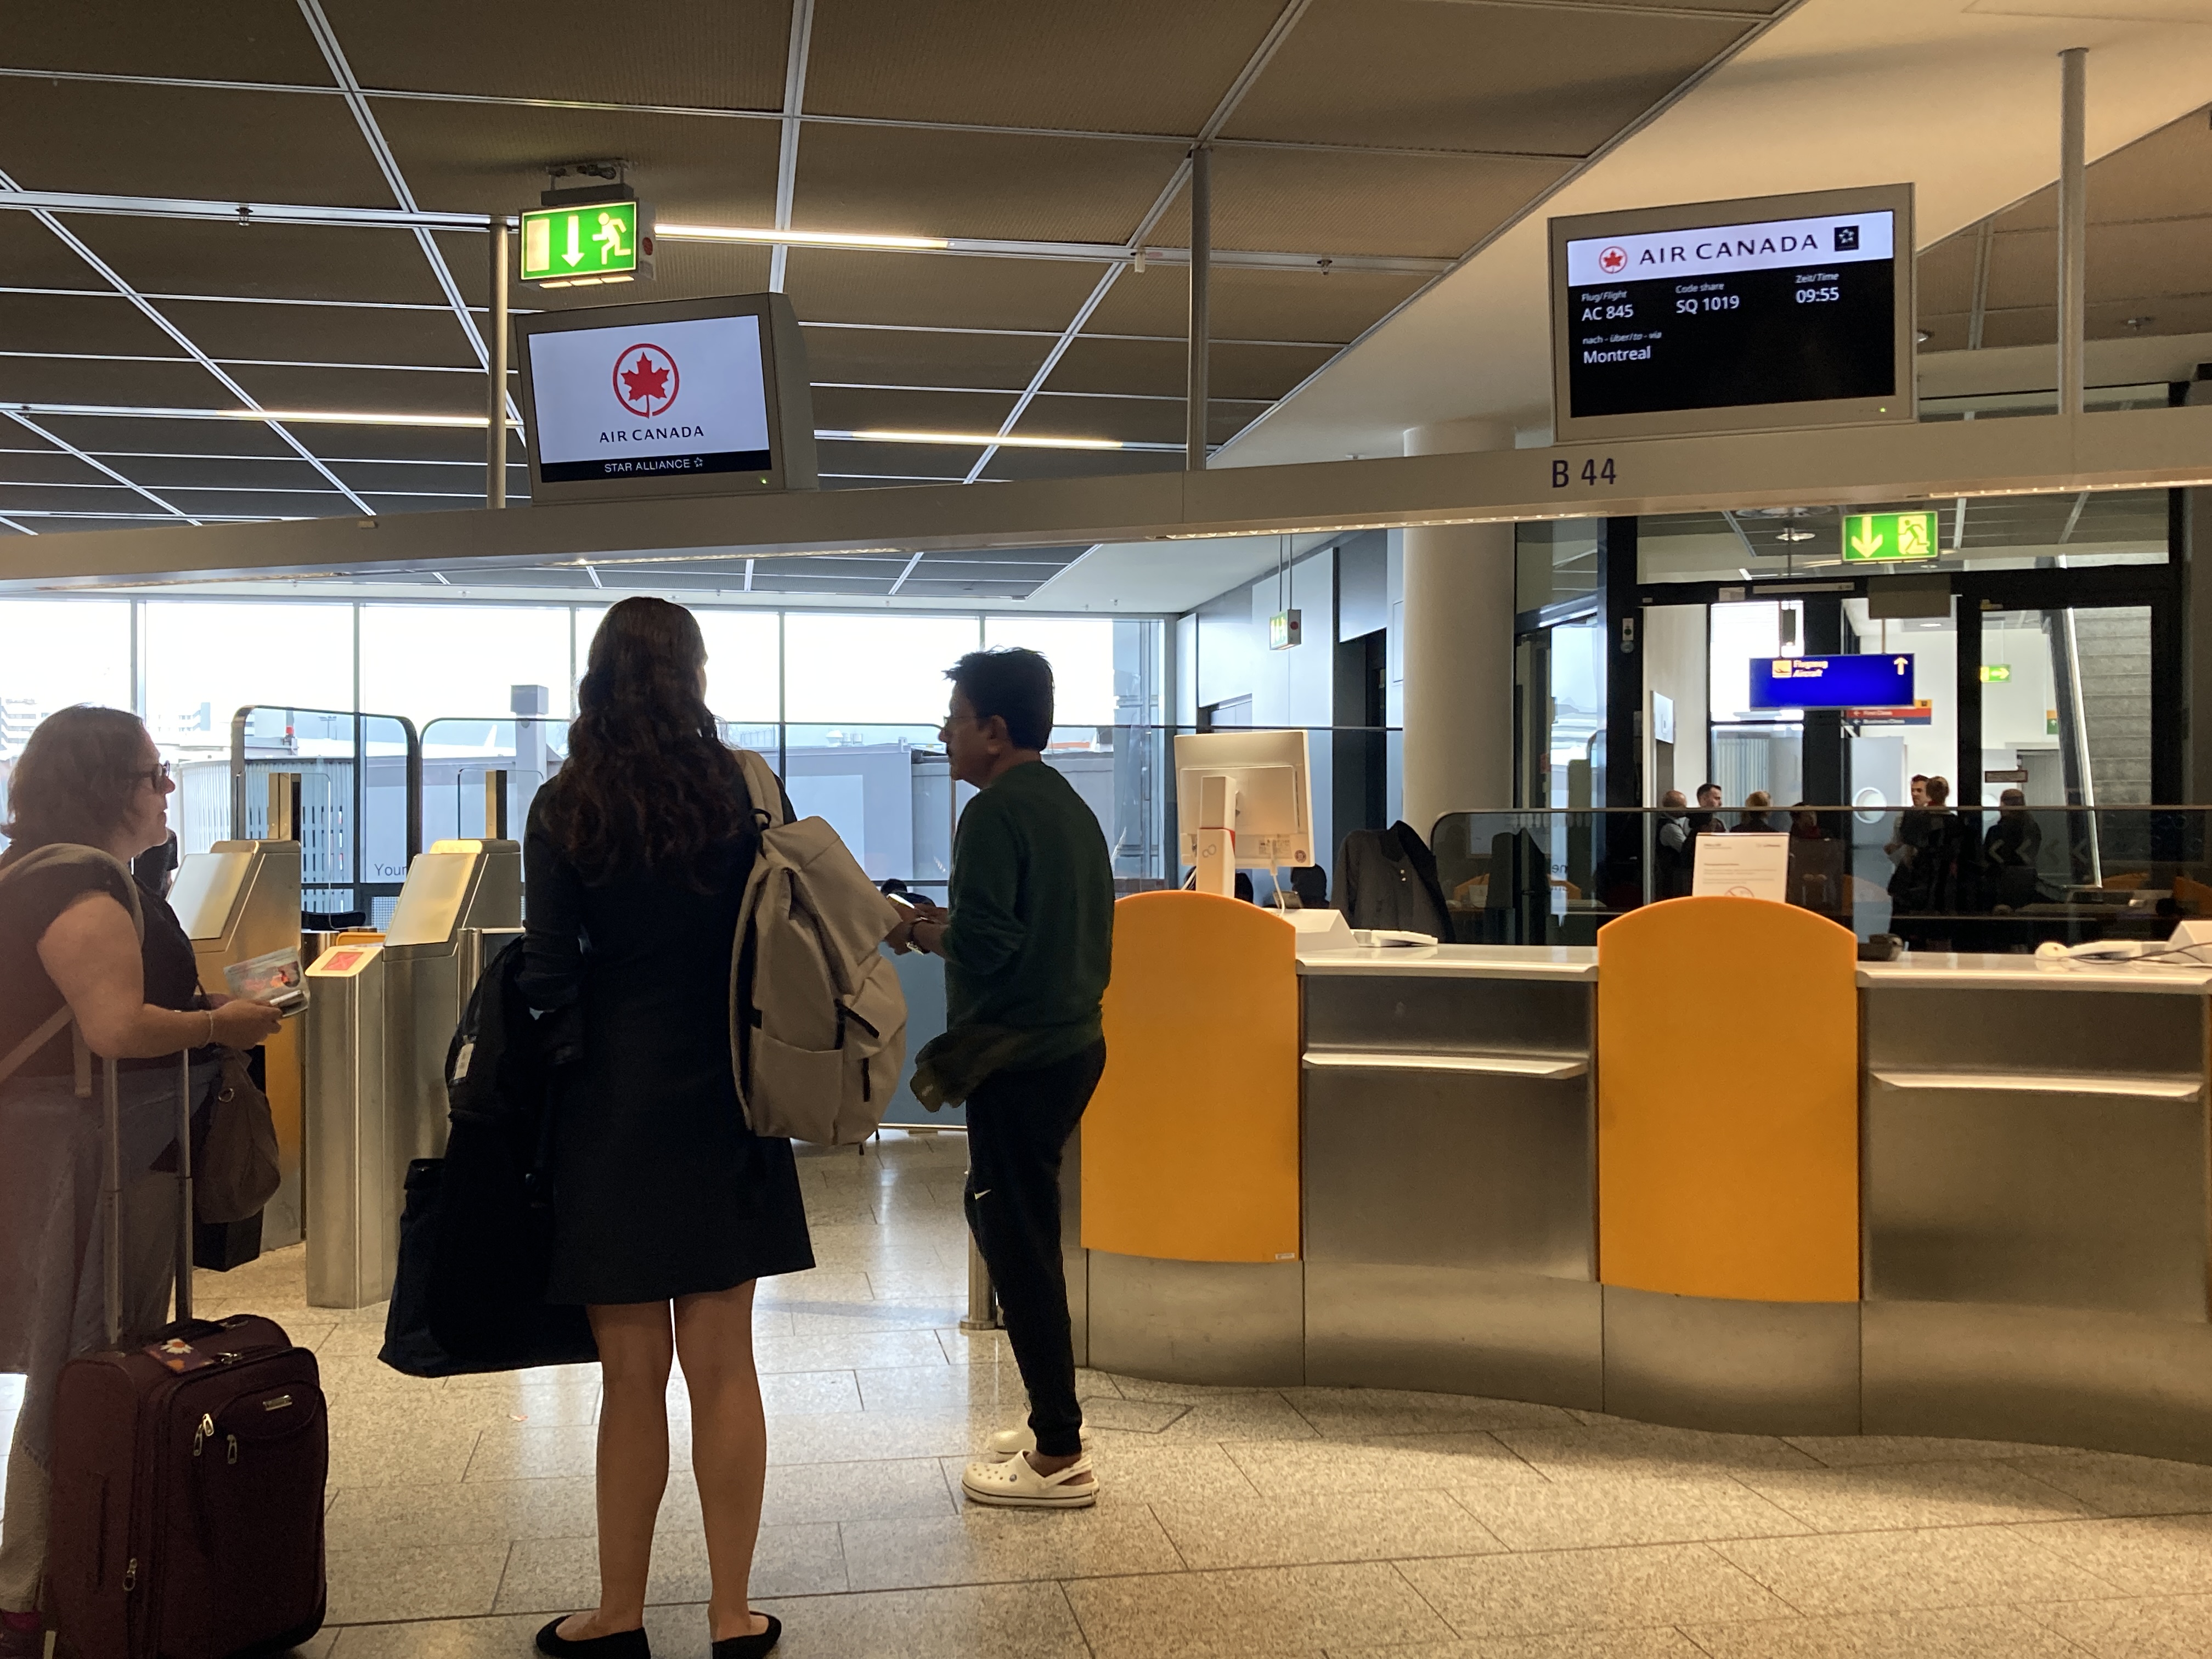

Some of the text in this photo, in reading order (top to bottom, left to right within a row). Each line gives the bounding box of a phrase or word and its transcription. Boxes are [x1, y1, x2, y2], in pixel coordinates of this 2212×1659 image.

[1639, 234, 1818, 265] AIR CANADA
[1581, 290, 1628, 303] Flug/Flight
[1675, 282, 1724, 294] Code share
[1795, 286, 1839, 303] 09:55
[1582, 304, 1634, 321] AC 845
[1676, 295, 1740, 314] SQ 1019
[1583, 335, 1604, 345] nach
[1583, 345, 1651, 364] Montreal
[599, 425, 704, 443] AIR CANADA
[605, 459, 691, 473] STAR ALLIANCE
[1551, 458, 1617, 488] B 44
[374, 864, 407, 876] Your
